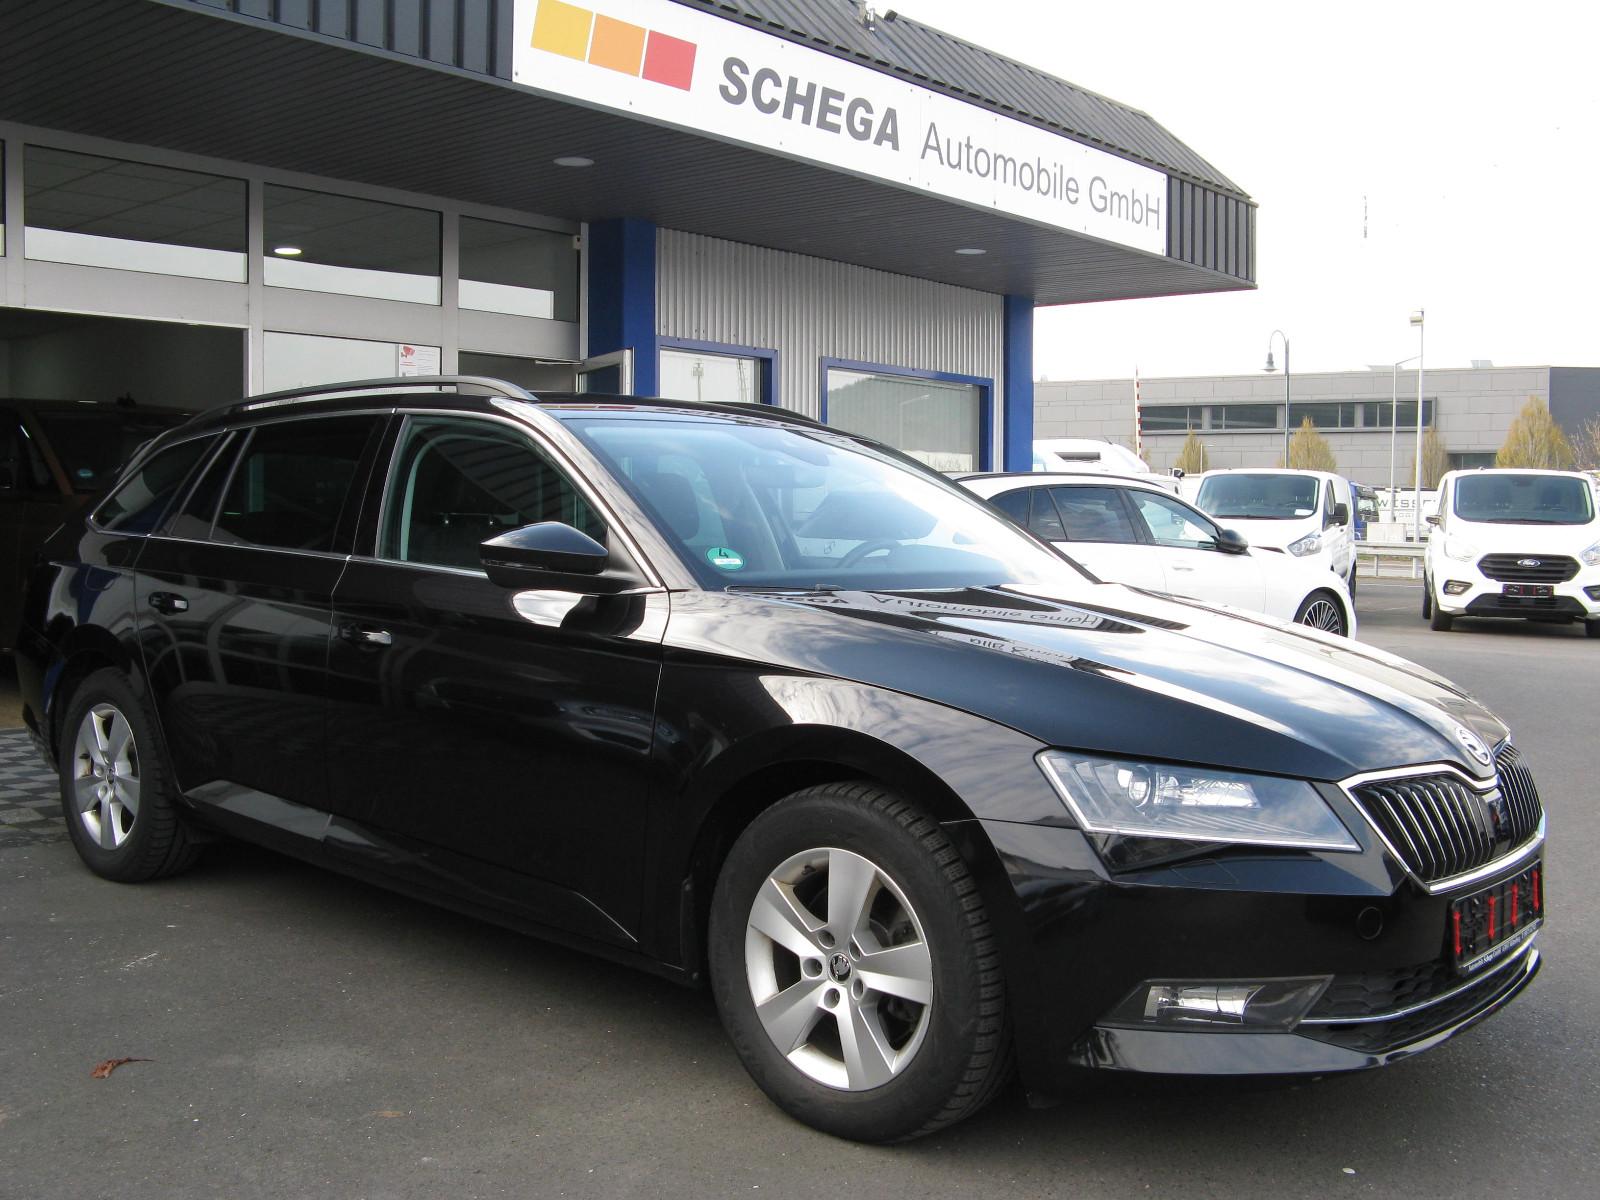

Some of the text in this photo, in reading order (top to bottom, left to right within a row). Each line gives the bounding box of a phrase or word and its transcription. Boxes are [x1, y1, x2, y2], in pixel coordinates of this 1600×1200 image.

[718, 57, 1161, 231] SCHEGA Automobile GmbH
